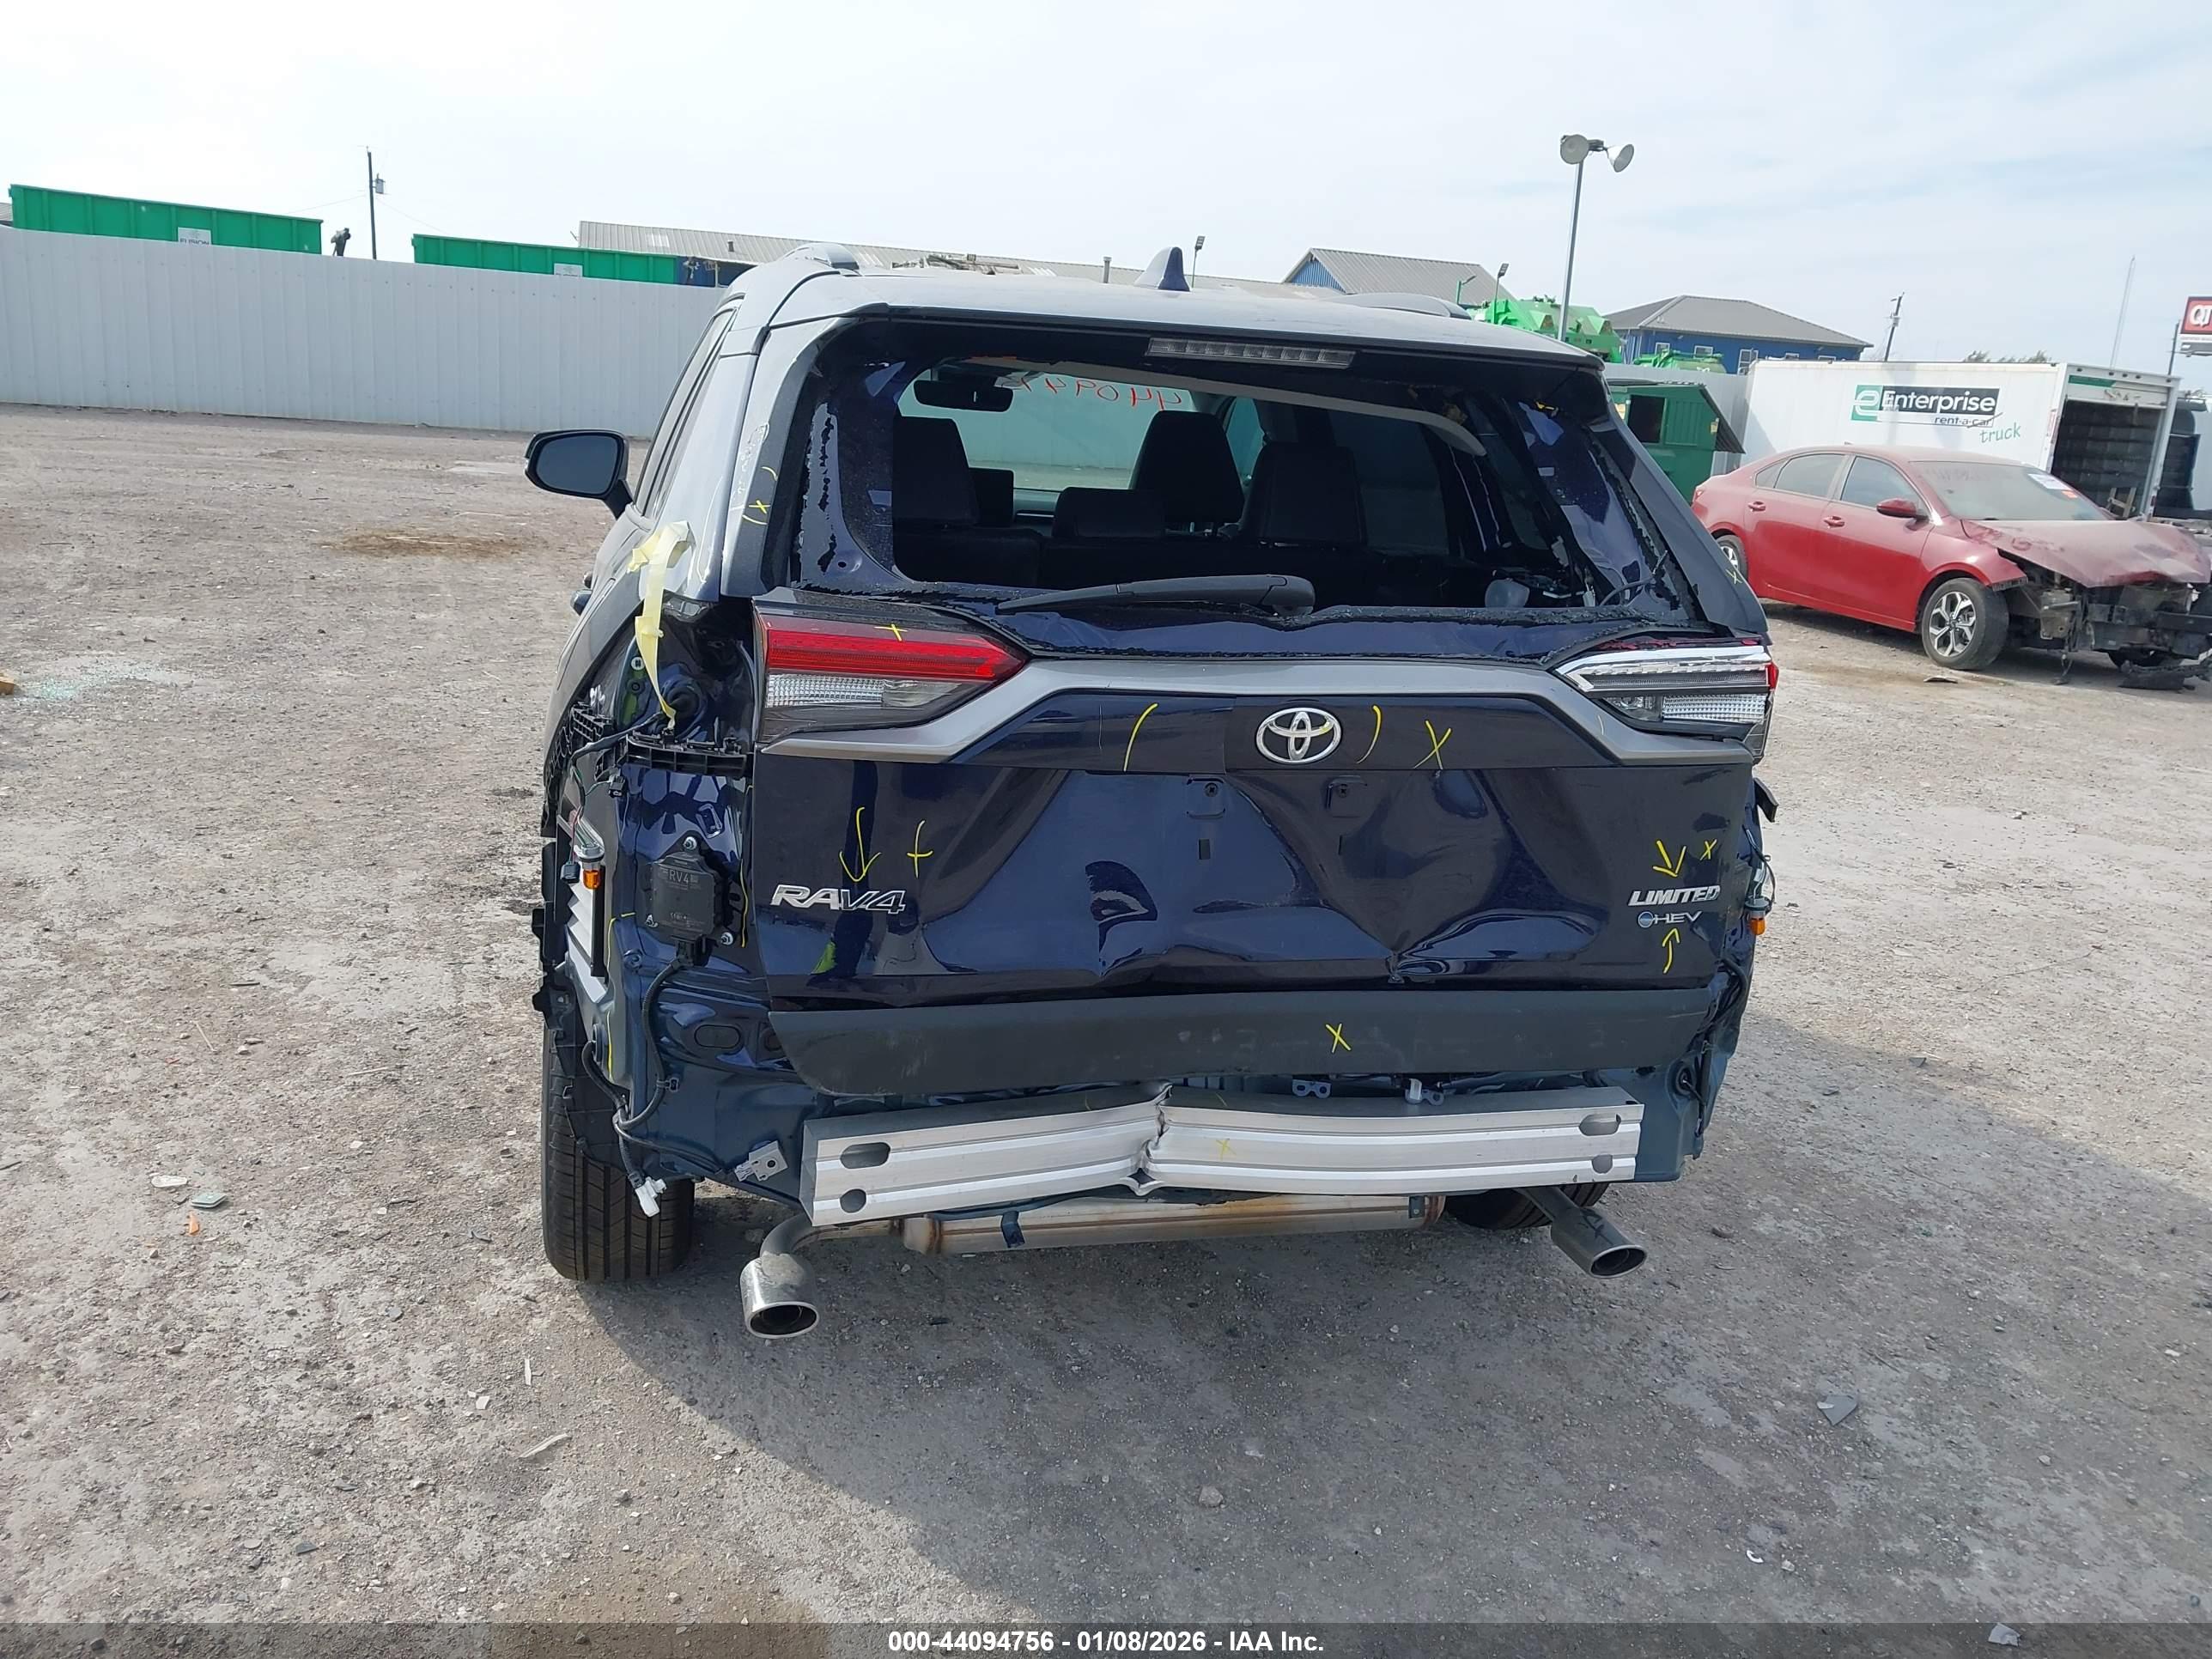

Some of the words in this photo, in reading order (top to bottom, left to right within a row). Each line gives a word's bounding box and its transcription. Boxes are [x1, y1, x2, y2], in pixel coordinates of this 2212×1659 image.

[2189, 304, 2212, 328] QT
[1881, 390, 1996, 414] Enterprise
[1979, 422, 2021, 443] truck
[770, 884, 906, 915] RAV4
[1627, 885, 1721, 906] LIMITED
